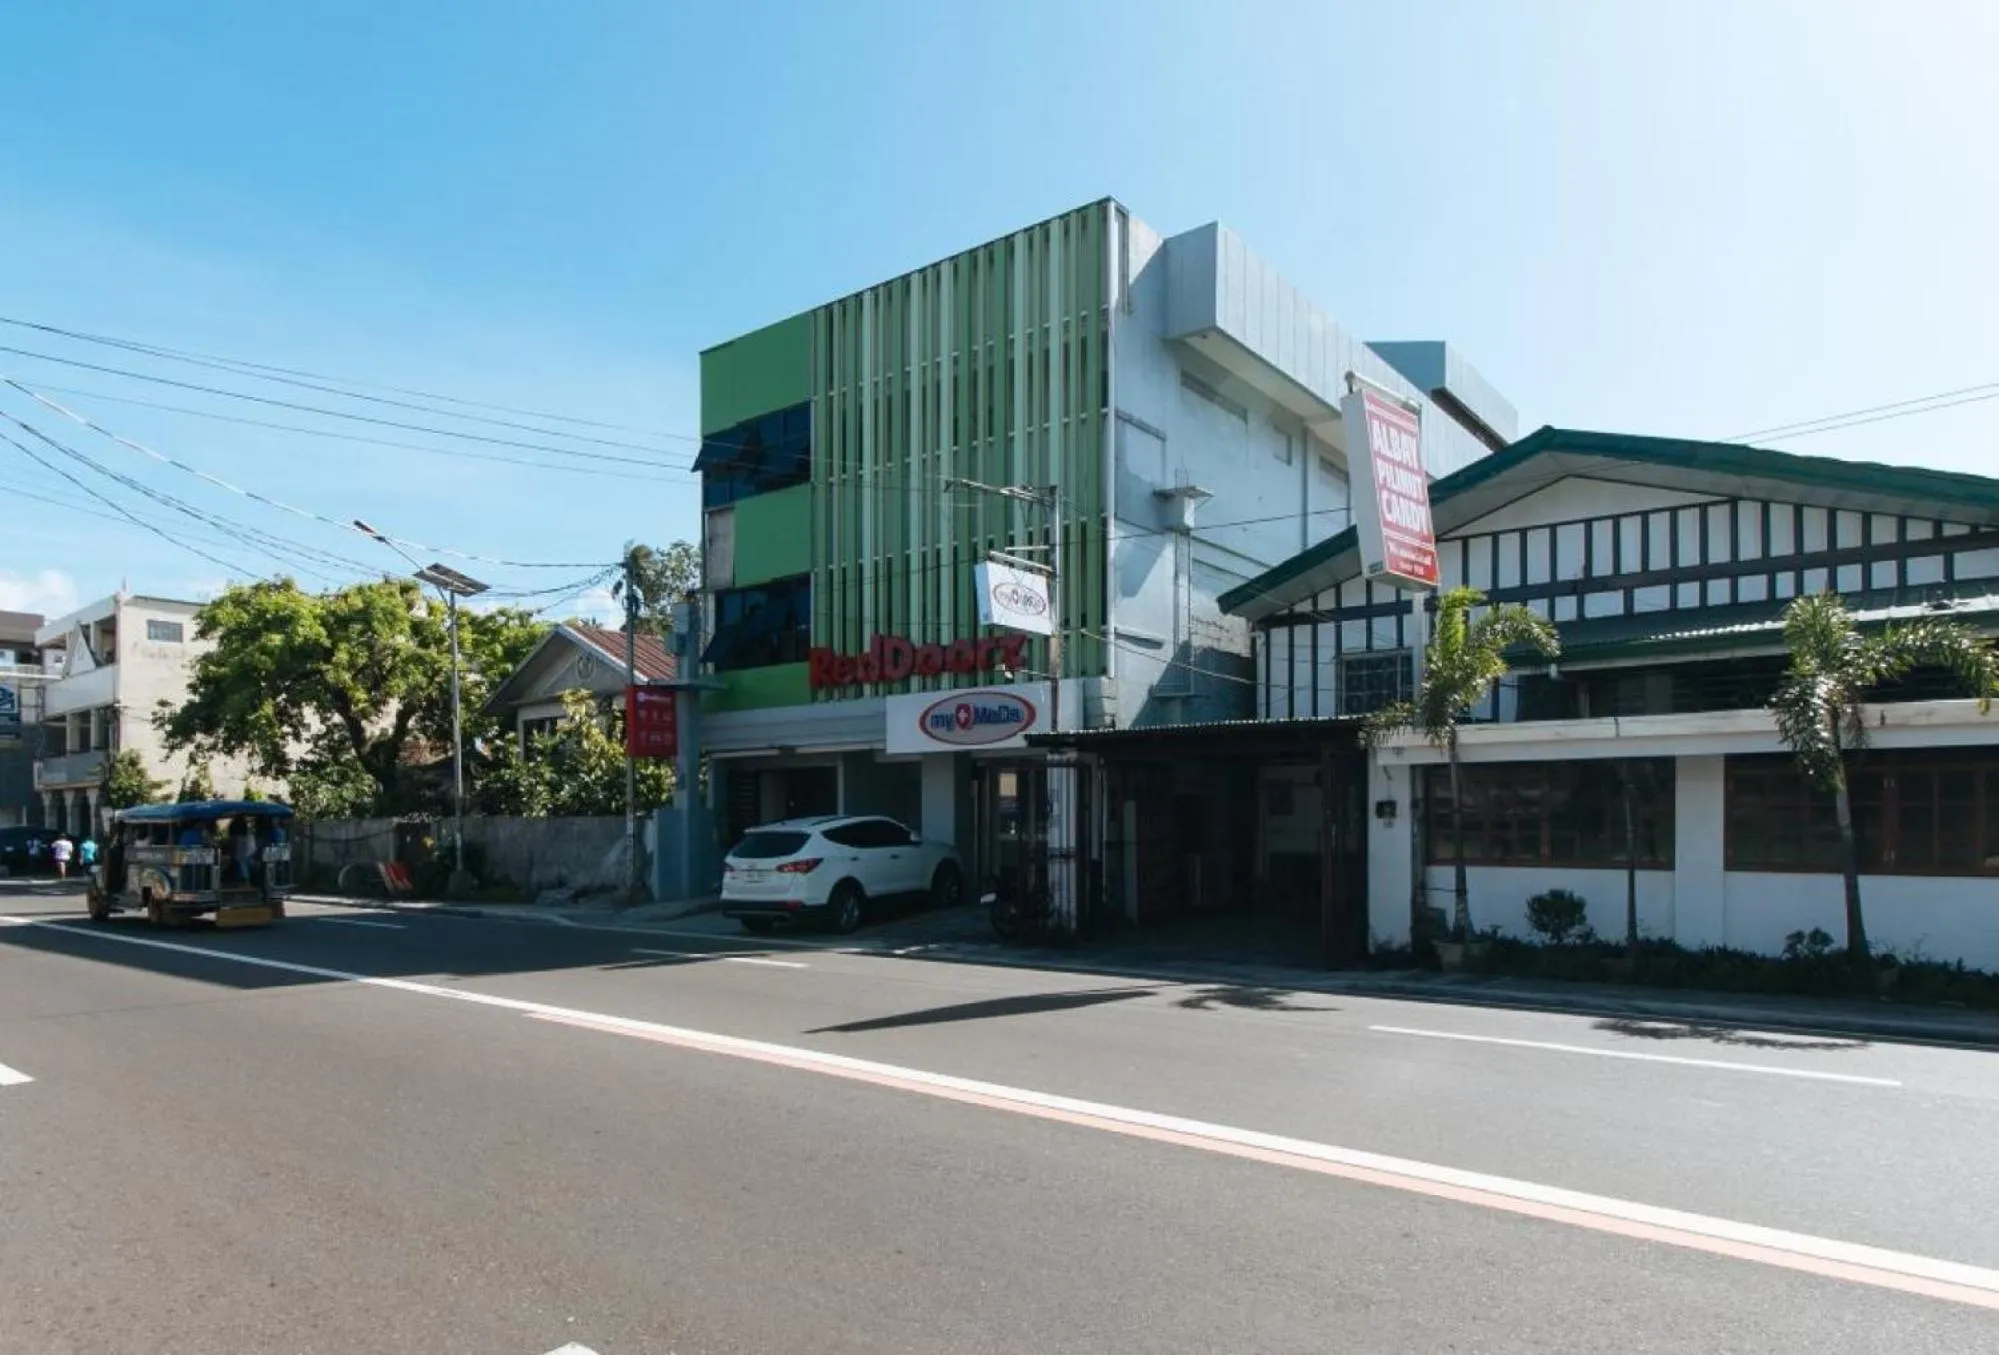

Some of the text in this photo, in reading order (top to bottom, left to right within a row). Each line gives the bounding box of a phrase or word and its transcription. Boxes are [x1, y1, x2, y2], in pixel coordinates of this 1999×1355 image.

[1371, 418, 1418, 468] ALBAY
[1381, 489, 1429, 534] CANDY
[810, 634, 1027, 689] RedDoorz
